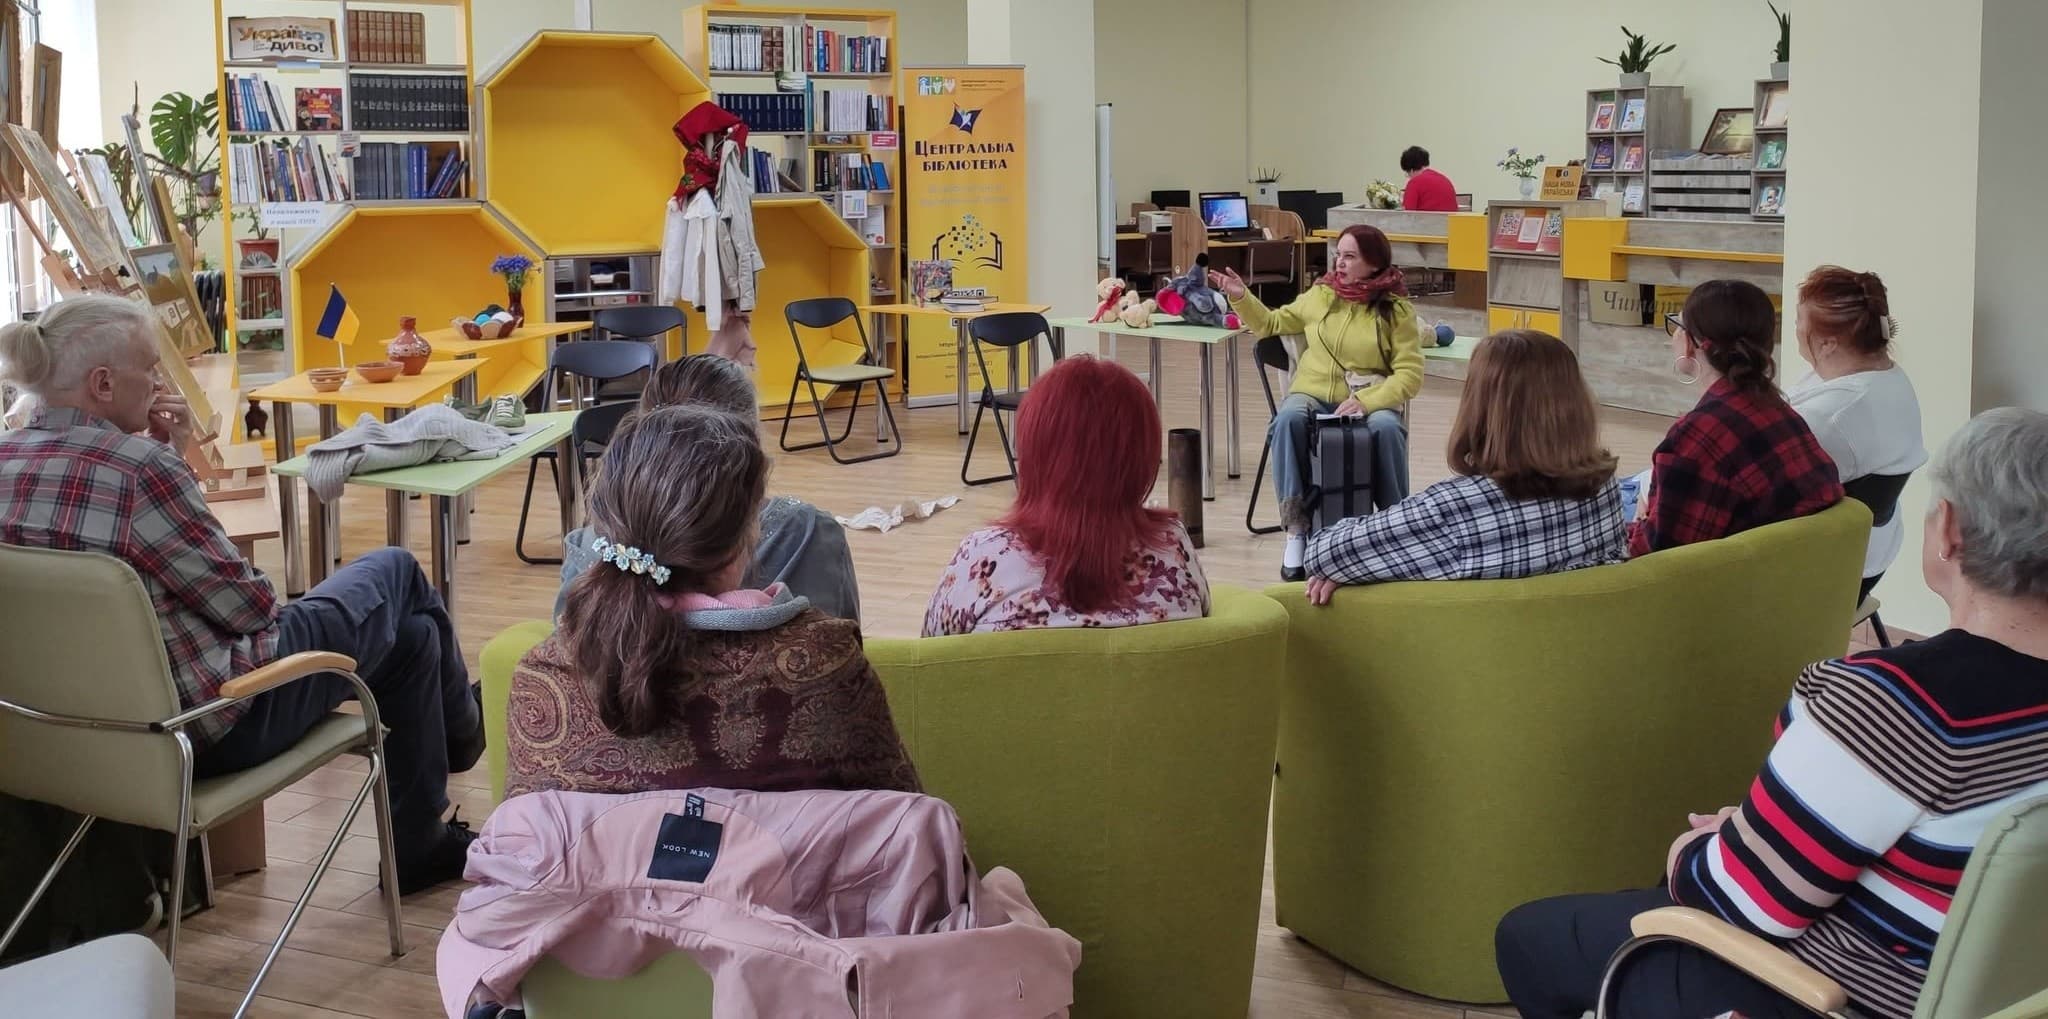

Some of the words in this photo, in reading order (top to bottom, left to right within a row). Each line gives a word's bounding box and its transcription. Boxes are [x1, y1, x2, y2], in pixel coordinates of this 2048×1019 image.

[915, 141, 1014, 157] ЦЕНТРАЛЬНА
[923, 159, 1007, 171] БІБЛІОТЕКА
[662, 843, 687, 852] LOOK
[690, 848, 711, 858] NEW
